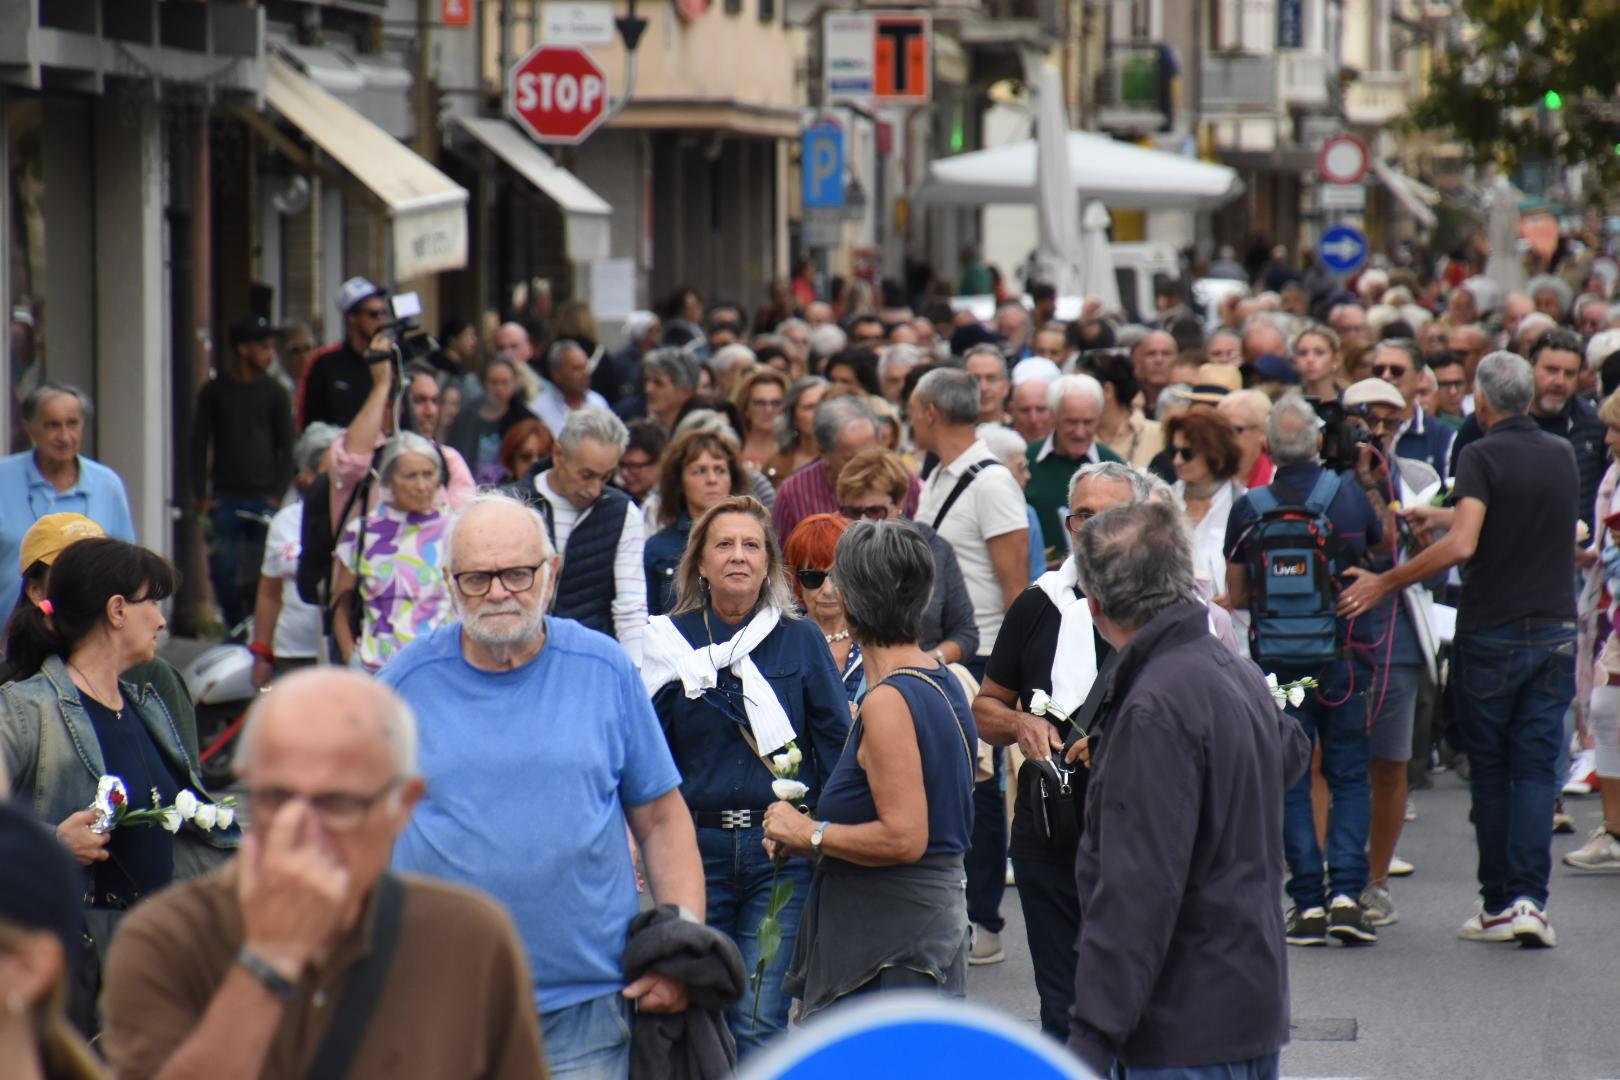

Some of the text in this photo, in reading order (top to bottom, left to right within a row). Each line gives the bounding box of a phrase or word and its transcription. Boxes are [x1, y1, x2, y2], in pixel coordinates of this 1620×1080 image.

[879, 24, 922, 92] T
[517, 71, 601, 113] STOP
[811, 138, 837, 200] P
